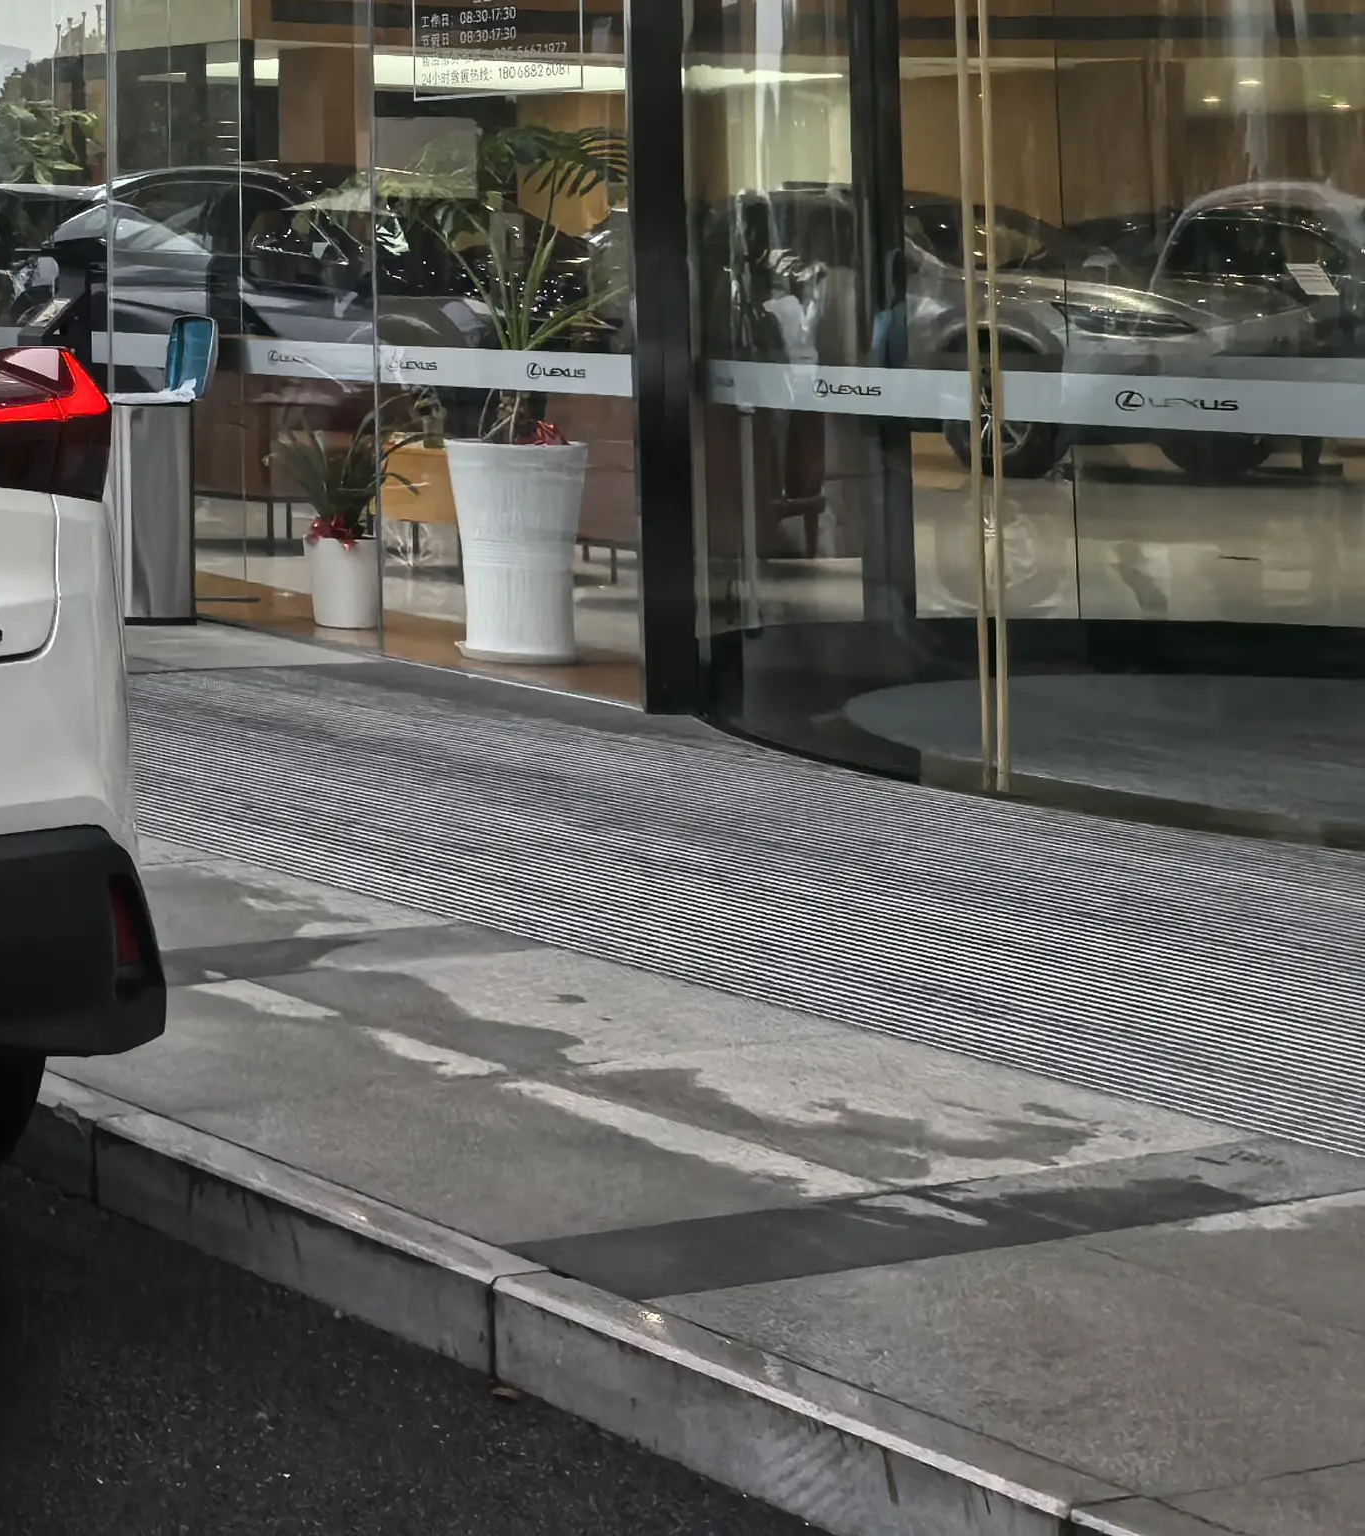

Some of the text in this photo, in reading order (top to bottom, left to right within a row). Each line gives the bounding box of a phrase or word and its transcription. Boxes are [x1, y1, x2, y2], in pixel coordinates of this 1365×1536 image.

[459, 7, 517, 25] 08:30-17:30
[459, 26, 517, 44] 08:30-17:30
[542, 367, 586, 378] LEXUS
[829, 383, 882, 396] LEXUS
